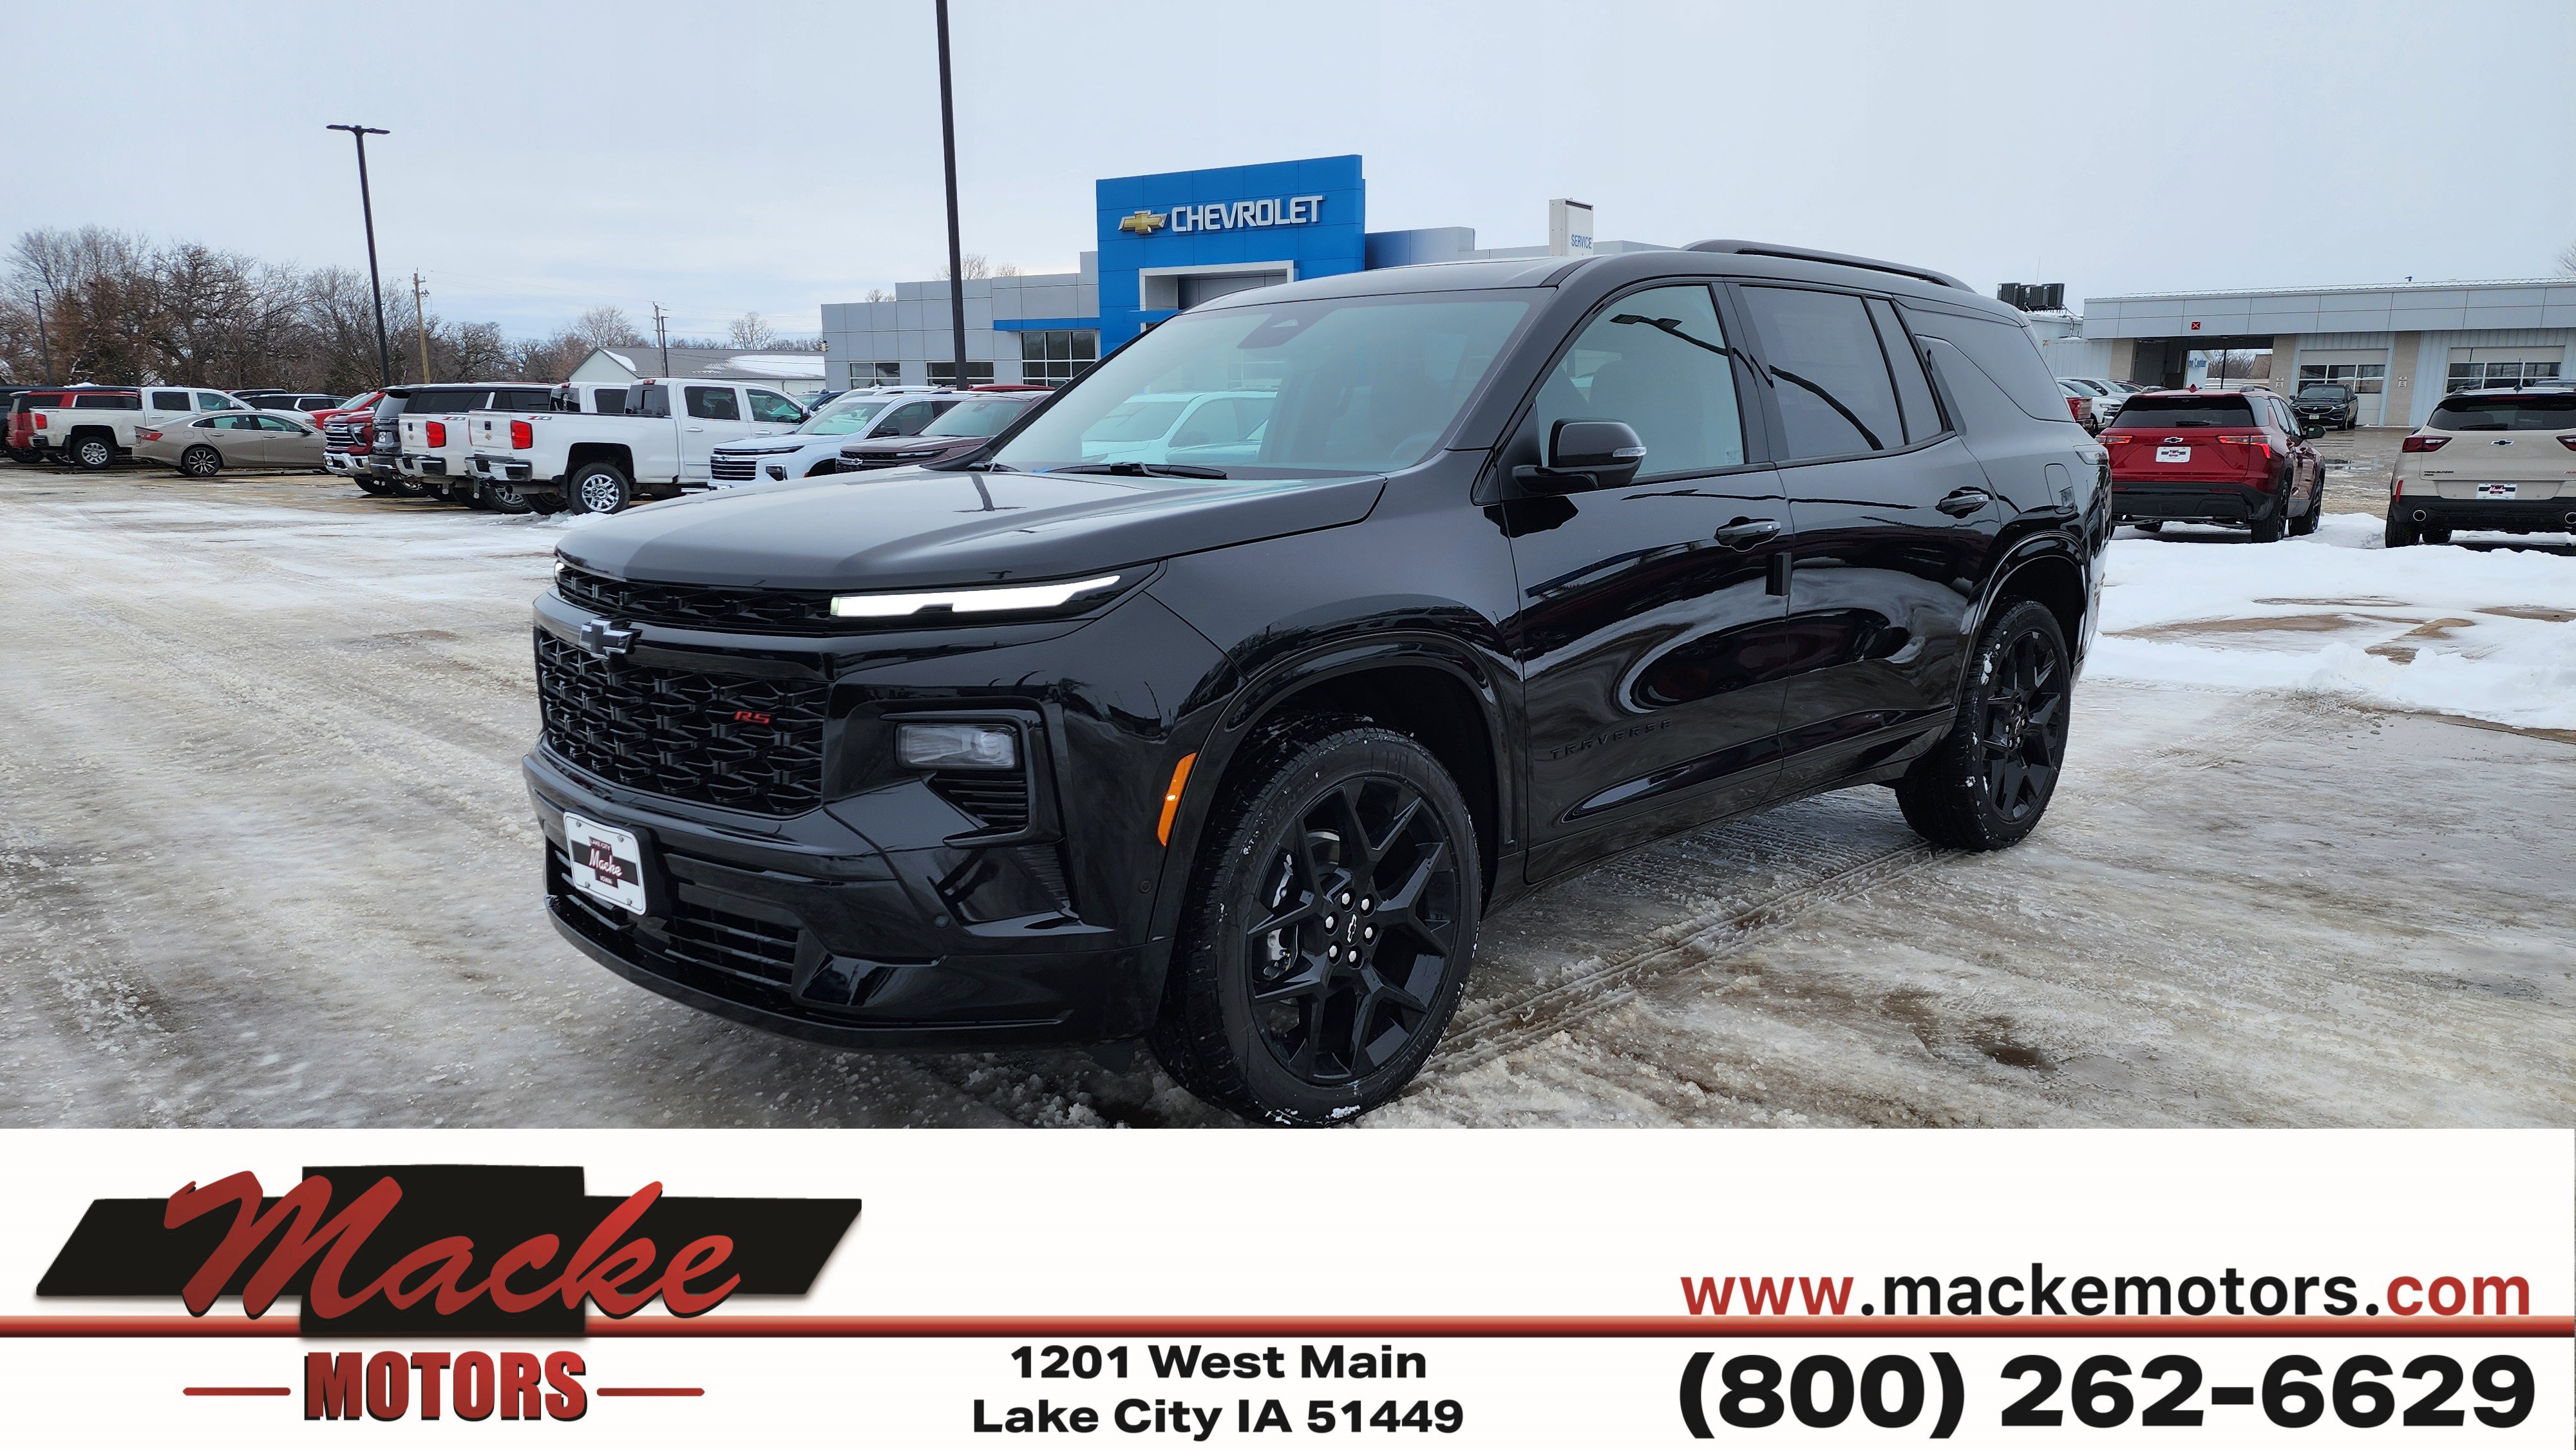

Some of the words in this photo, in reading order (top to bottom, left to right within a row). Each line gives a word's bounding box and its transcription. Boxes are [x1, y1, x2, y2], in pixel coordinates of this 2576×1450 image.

[1171, 195, 1323, 232] CHEVROLET
[1571, 234, 1592, 249] SERVICE
[734, 710, 772, 725] RS
[1550, 719, 1673, 760] TRAVERSE
[589, 848, 623, 877] Macke
